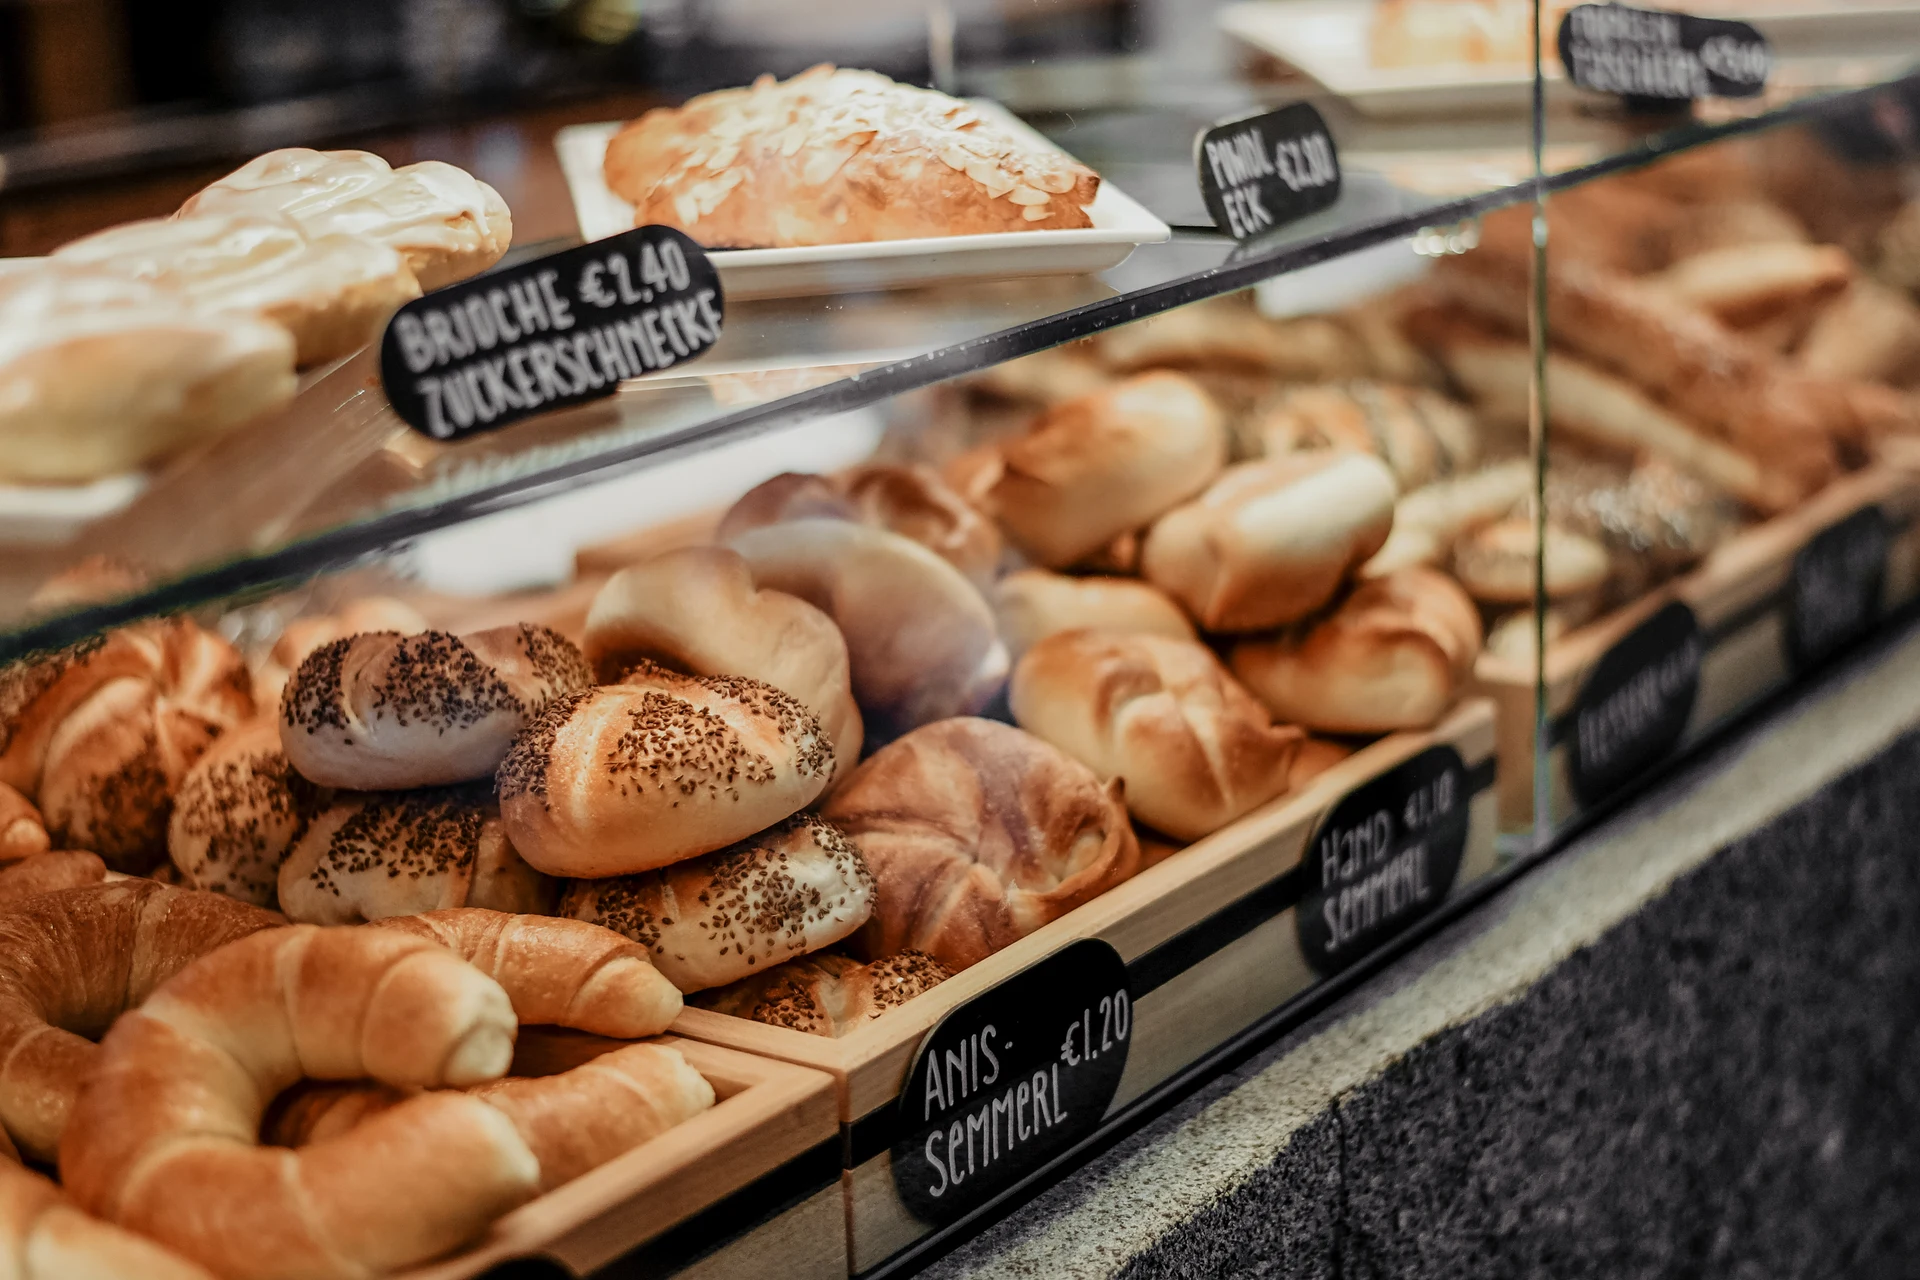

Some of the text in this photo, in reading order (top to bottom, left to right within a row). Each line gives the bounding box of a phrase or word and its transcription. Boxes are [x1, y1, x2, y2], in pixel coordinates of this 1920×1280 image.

[1222, 182, 1274, 239] ECK
[397, 269, 577, 374] BRIOCHE
[414, 288, 724, 438] ZUCKERSCHNECKE
